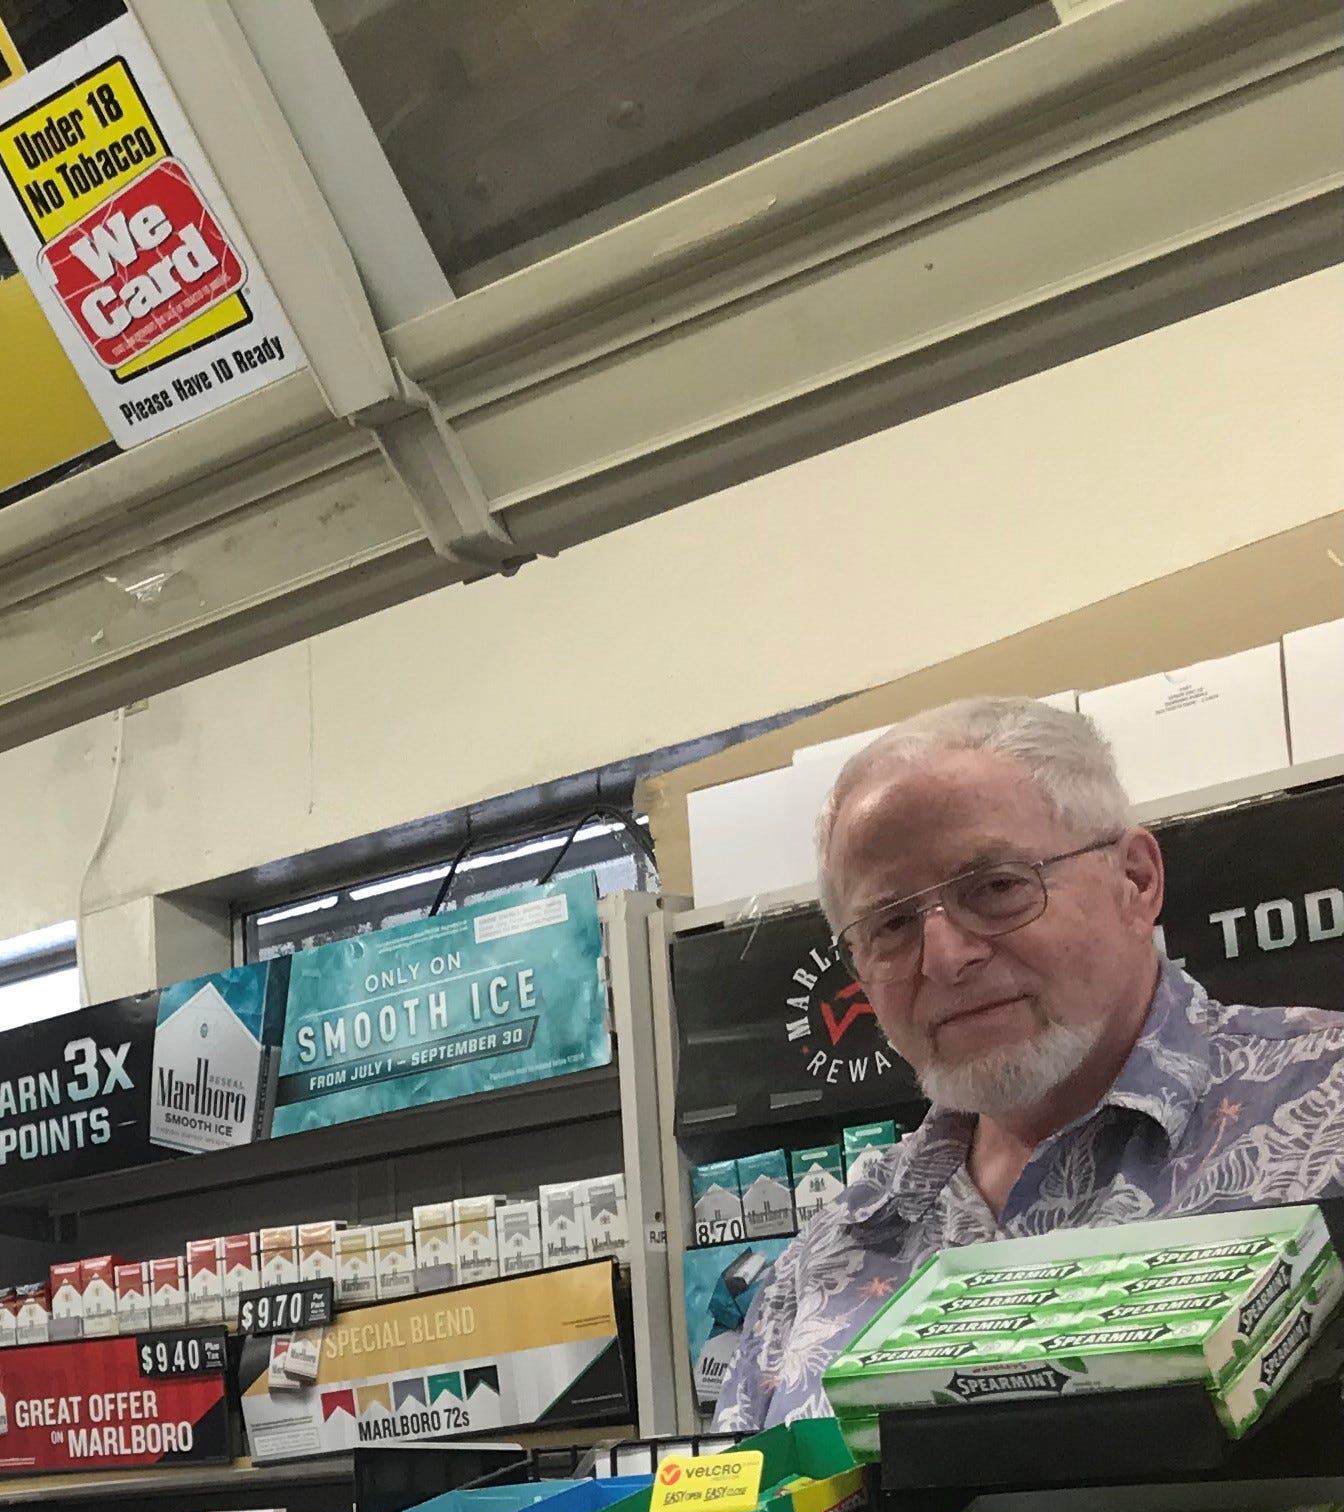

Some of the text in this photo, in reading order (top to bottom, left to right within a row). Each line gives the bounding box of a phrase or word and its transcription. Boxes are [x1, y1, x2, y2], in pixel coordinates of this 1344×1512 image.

[14, 82, 124, 170] Under 18
[25, 126, 156, 219] No Tobacco
[70, 204, 173, 281] We
[80, 223, 220, 340] Card
[119, 335, 285, 426] Please Have ID Ready
[365, 951, 462, 993] ONLY ON
[298, 968, 536, 1063] SMOOTH ICE
[63, 1036, 135, 1102] 3x
[309, 1070, 346, 1091] FROM
[350, 1061, 383, 1080] JULY
[387, 1057, 392, 1072] 1
[411, 1037, 496, 1066] SEPTEMBER
[502, 1028, 523, 1046] 30
[157, 1057, 246, 1123] Marlboro
[164, 1113, 212, 1133] SMOOTH
[214, 1124, 233, 1137] ICE
[968, 1263, 1078, 1287] SPEARMINT
[241, 1292, 302, 1330] $9.70
[324, 1306, 474, 1359] SPECIAL BLEND
[141, 1339, 199, 1373] $9.40
[957, 1369, 1068, 1396] SPEARMINT
[15, 1390, 158, 1427] GREAT OFFER
[358, 1407, 470, 1443] MARLBORO 72s
[51, 1421, 193, 1458] ON MARLBORO
[664, 1489, 685, 1505] EASY
[703, 1487, 727, 1501] EASY
